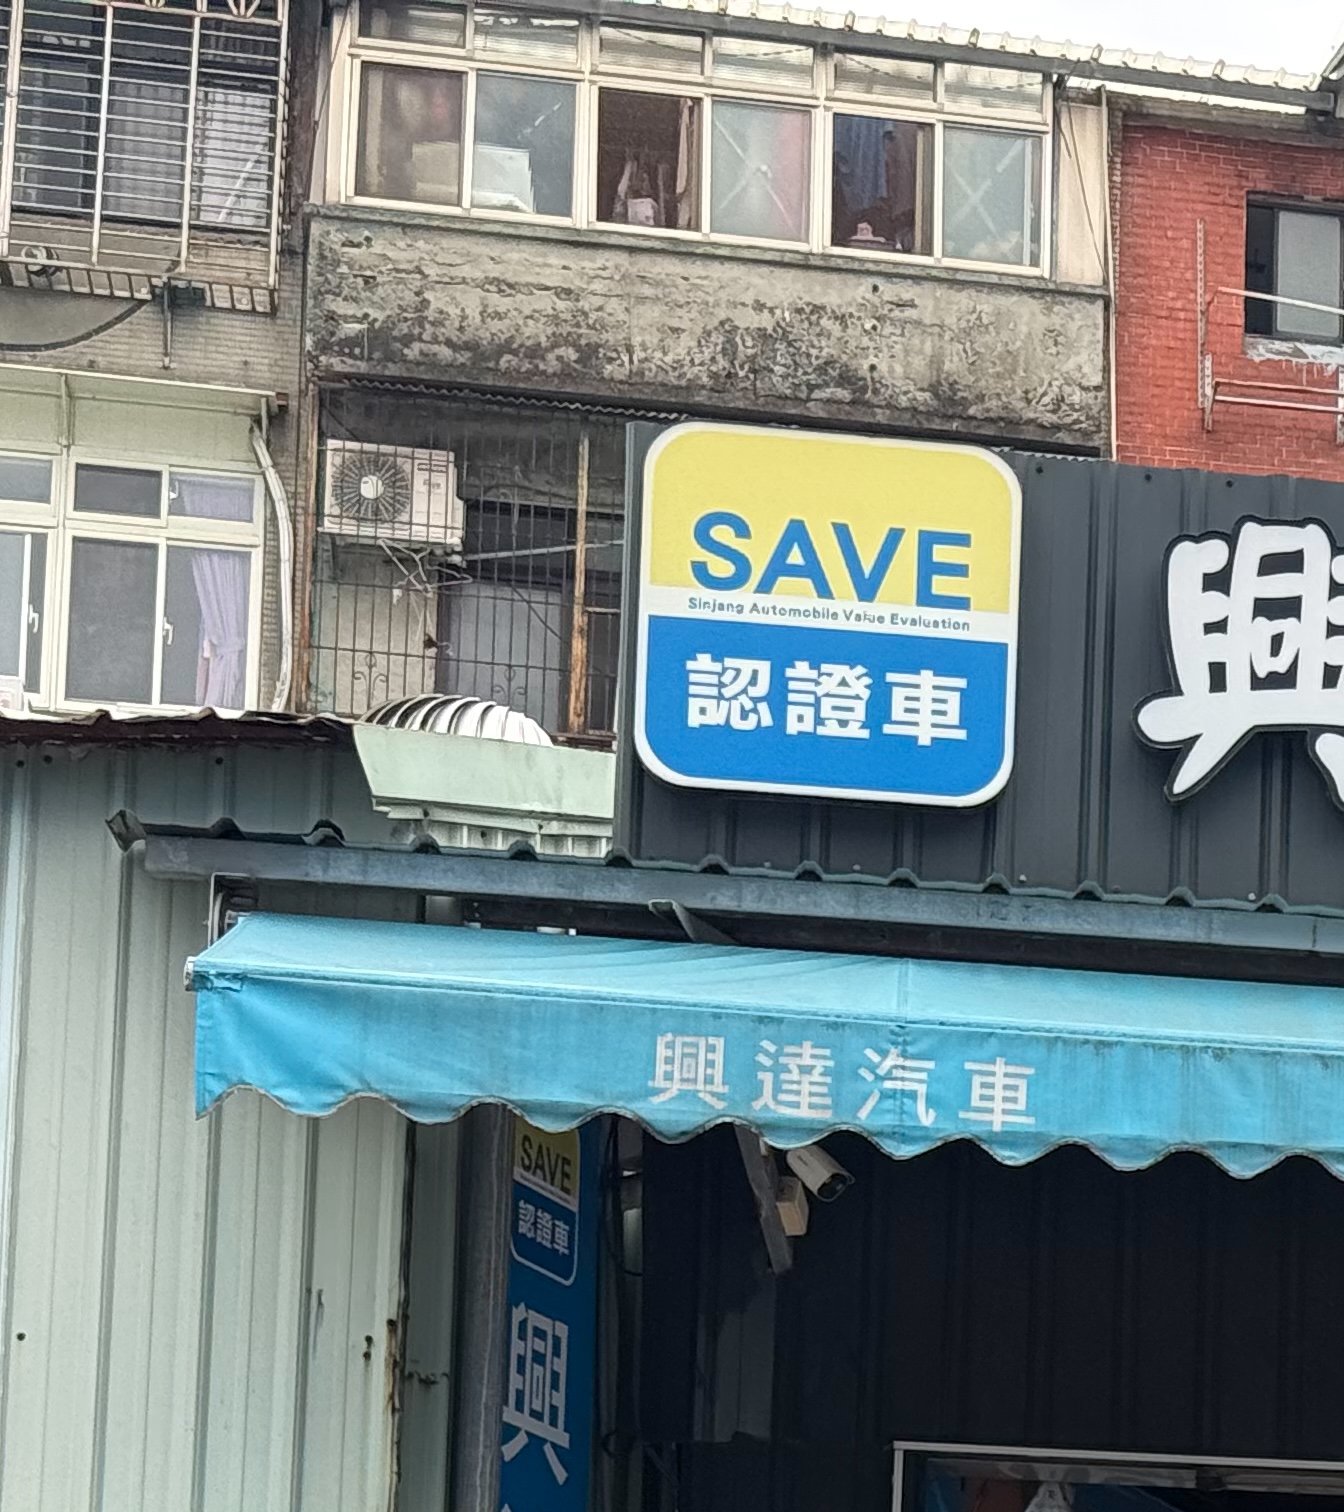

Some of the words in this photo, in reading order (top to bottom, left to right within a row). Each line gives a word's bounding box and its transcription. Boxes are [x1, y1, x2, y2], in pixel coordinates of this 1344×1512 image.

[690, 511, 973, 610] SAVE
[688, 597, 744, 614] Sinjang
[750, 602, 838, 621] Automobile
[843, 609, 886, 625] Value
[890, 613, 970, 632] Evaluation
[686, 653, 969, 746] 認證車
[649, 1032, 1037, 1132] 興達汽車
[521, 1134, 572, 1196] SAVE
[518, 1199, 570, 1257] 認證車
